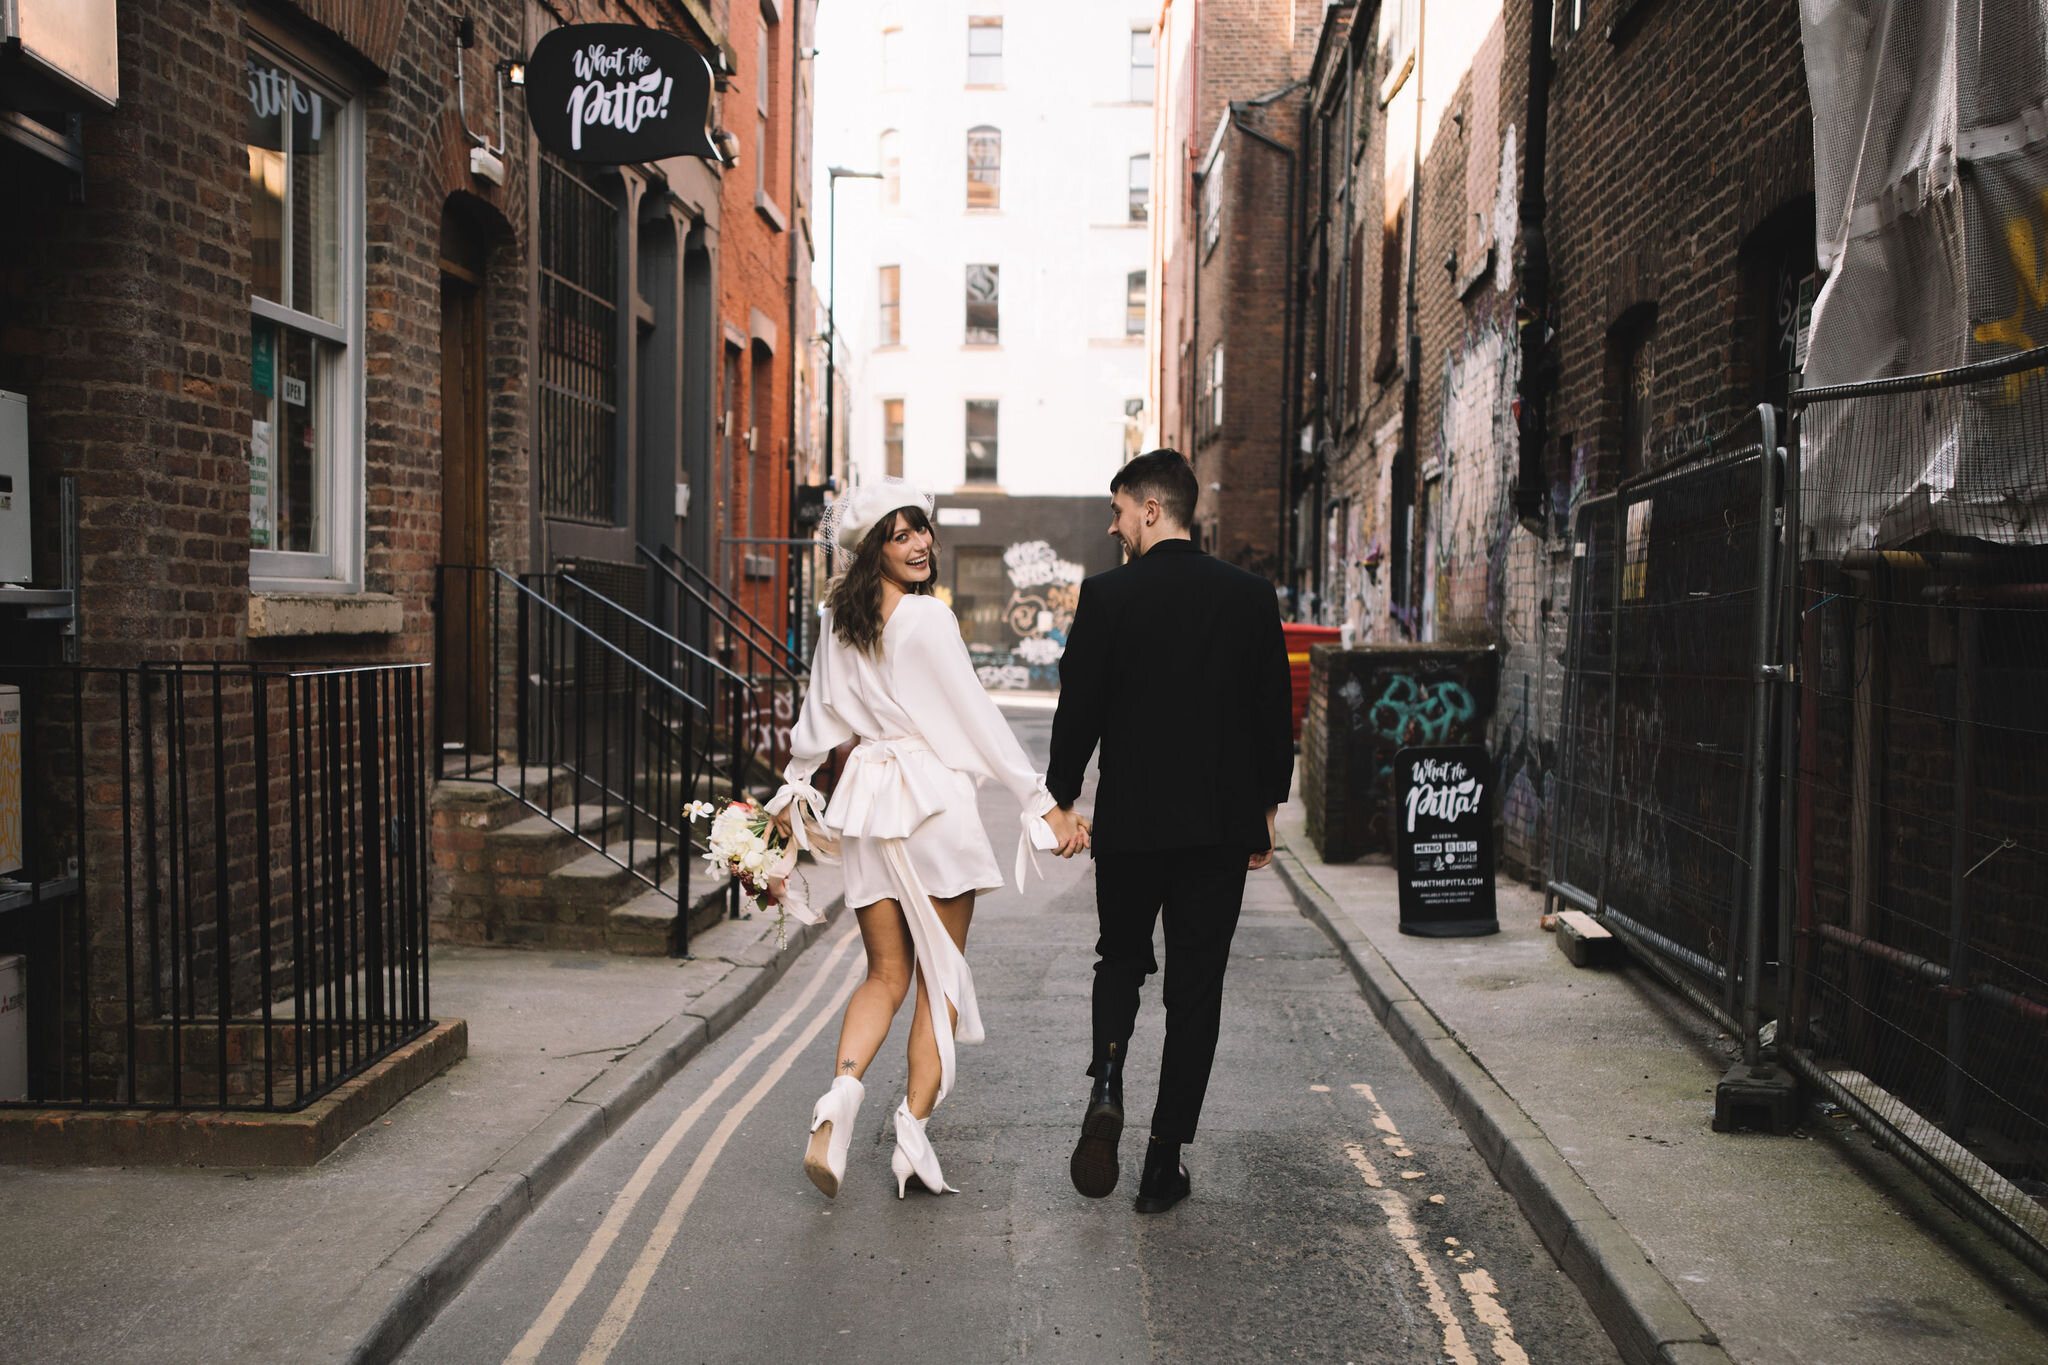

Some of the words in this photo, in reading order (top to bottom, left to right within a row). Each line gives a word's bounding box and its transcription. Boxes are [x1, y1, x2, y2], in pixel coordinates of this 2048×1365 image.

[572, 44, 628, 81] What
[627, 47, 652, 75] the
[566, 76, 674, 150] Pitta!
[286, 381, 302, 401] OPEN
[1412, 758, 1452, 784] What
[1450, 762, 1467, 781] the
[1405, 783, 1483, 832] Pitta!
[1446, 843, 1476, 851] BBC
[1411, 878, 1483, 888] WHATTHEPITTA.COM
